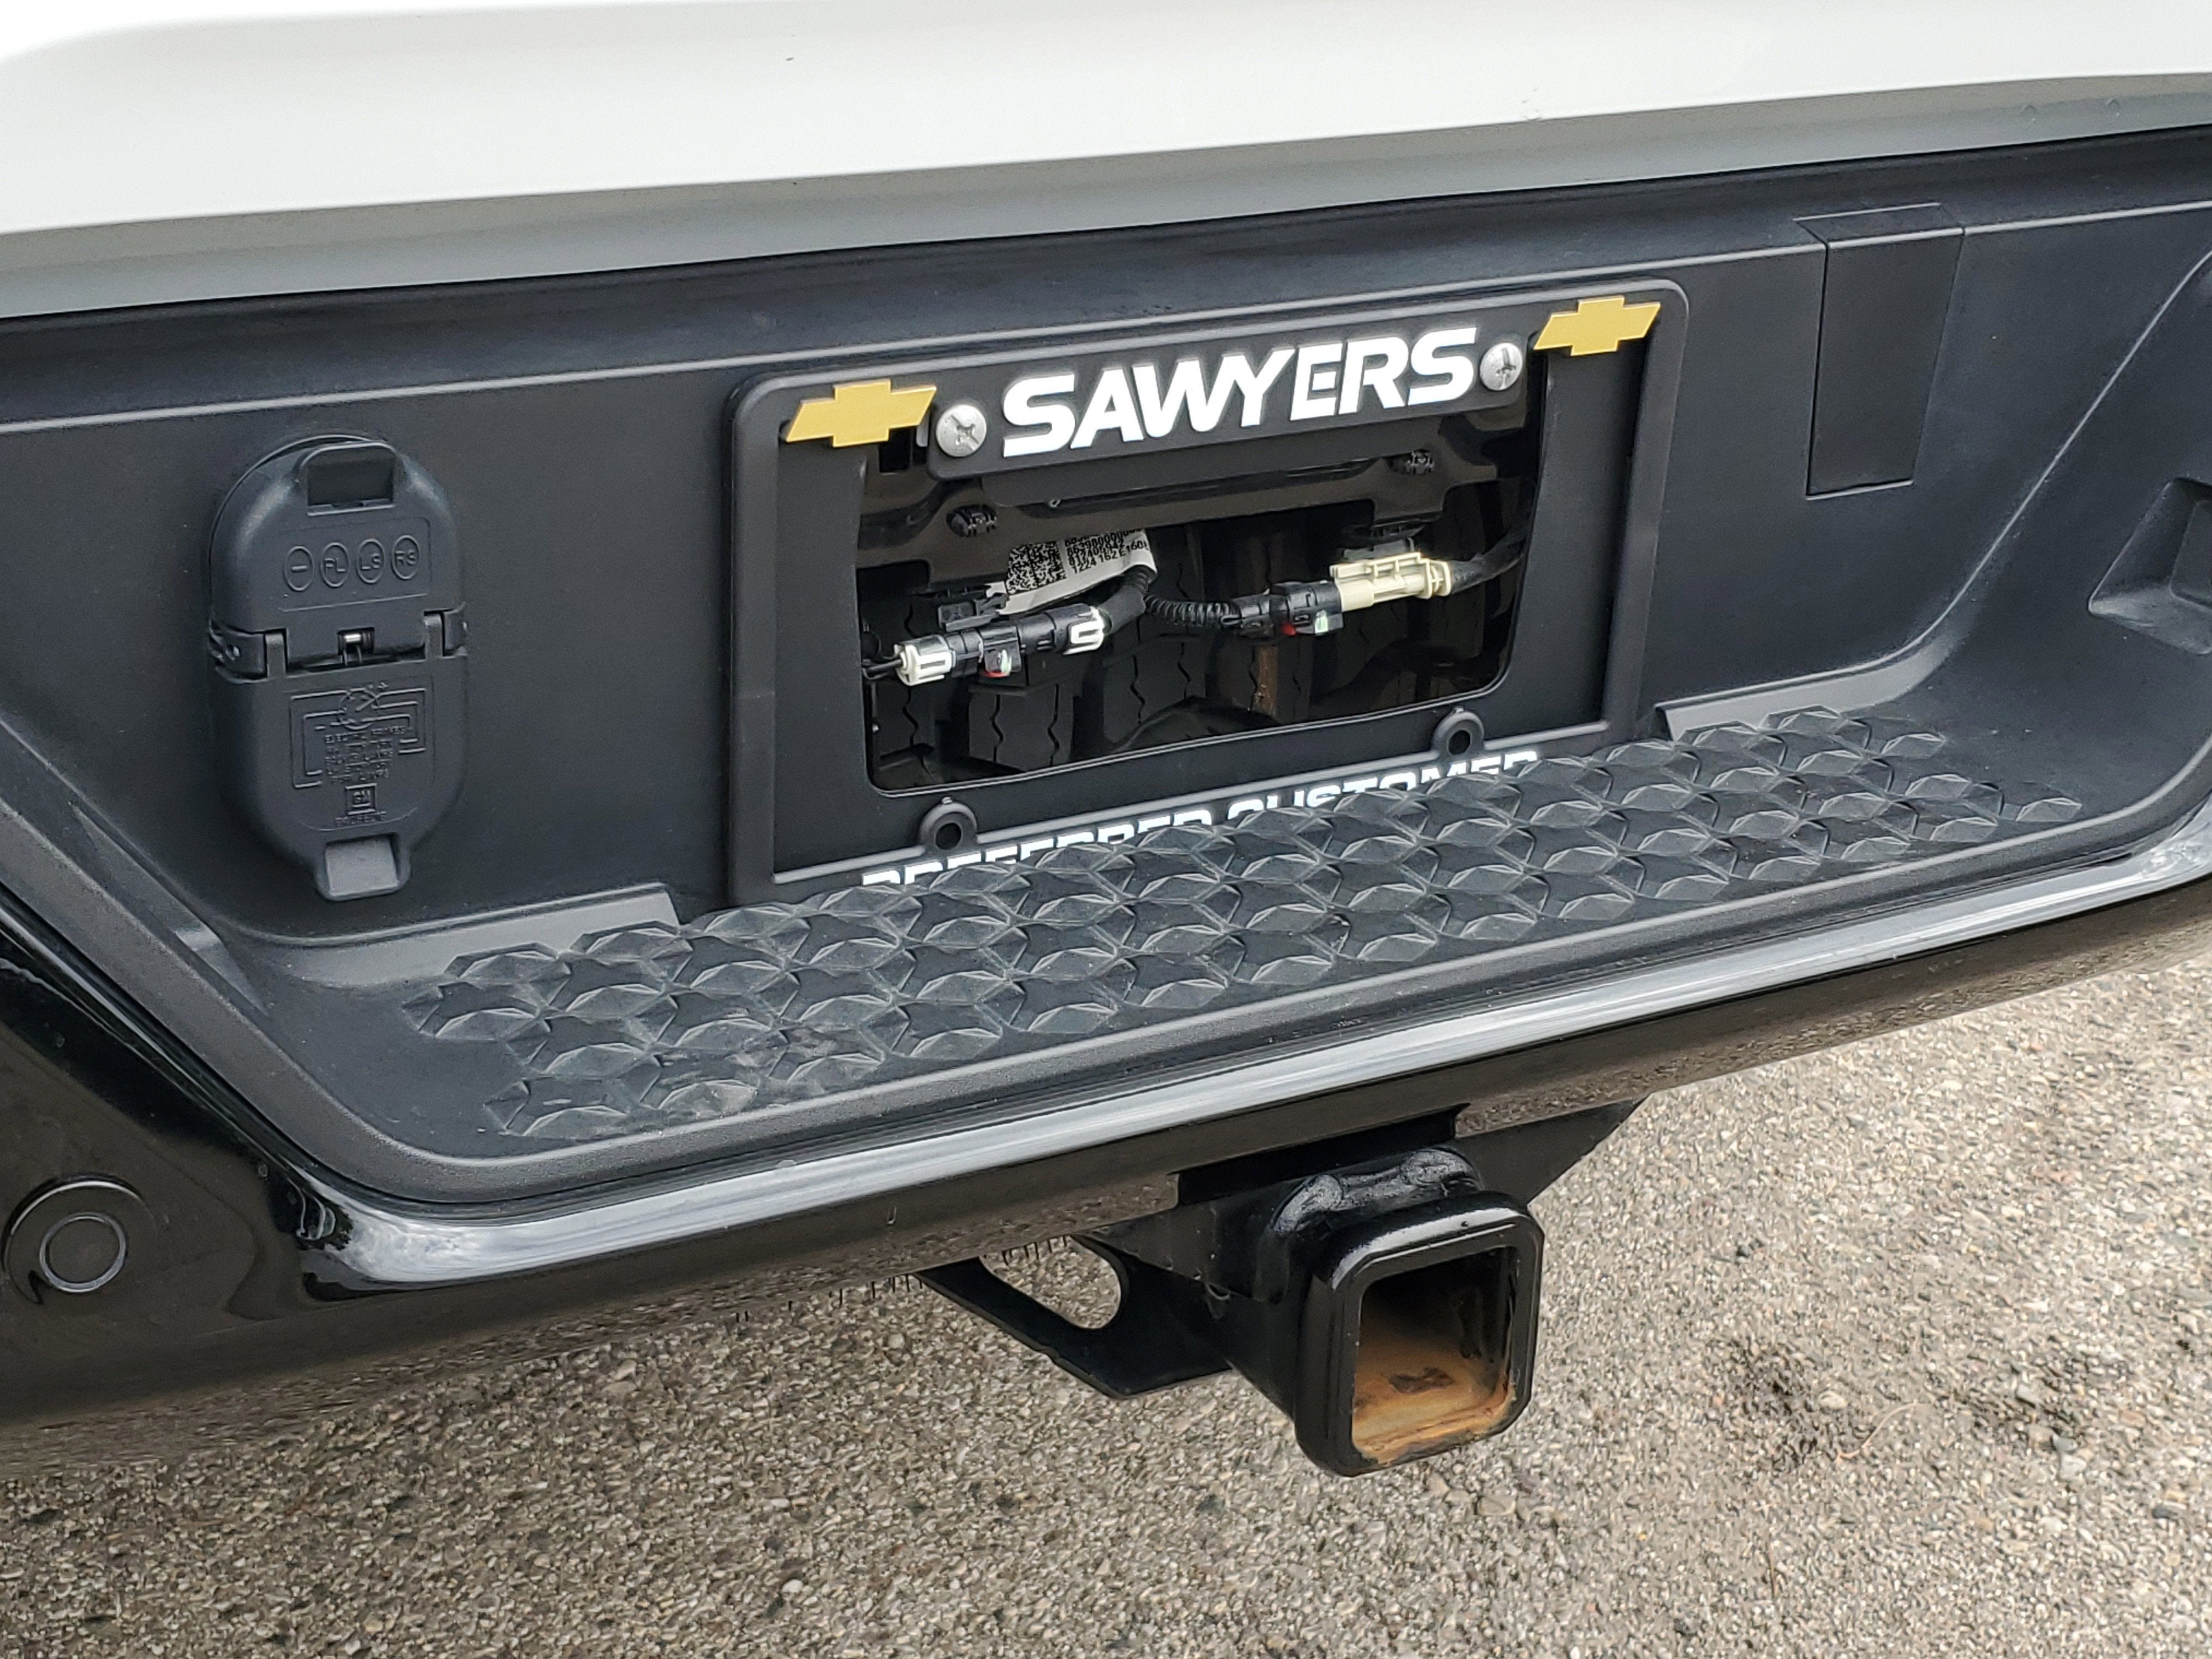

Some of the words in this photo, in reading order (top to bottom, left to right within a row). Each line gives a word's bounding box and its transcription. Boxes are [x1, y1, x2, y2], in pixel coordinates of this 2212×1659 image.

[1003, 327, 1477, 458] SAWYERS
[324, 556, 346, 575] PL
[359, 553, 381, 570] LS
[395, 549, 416, 566] RS
